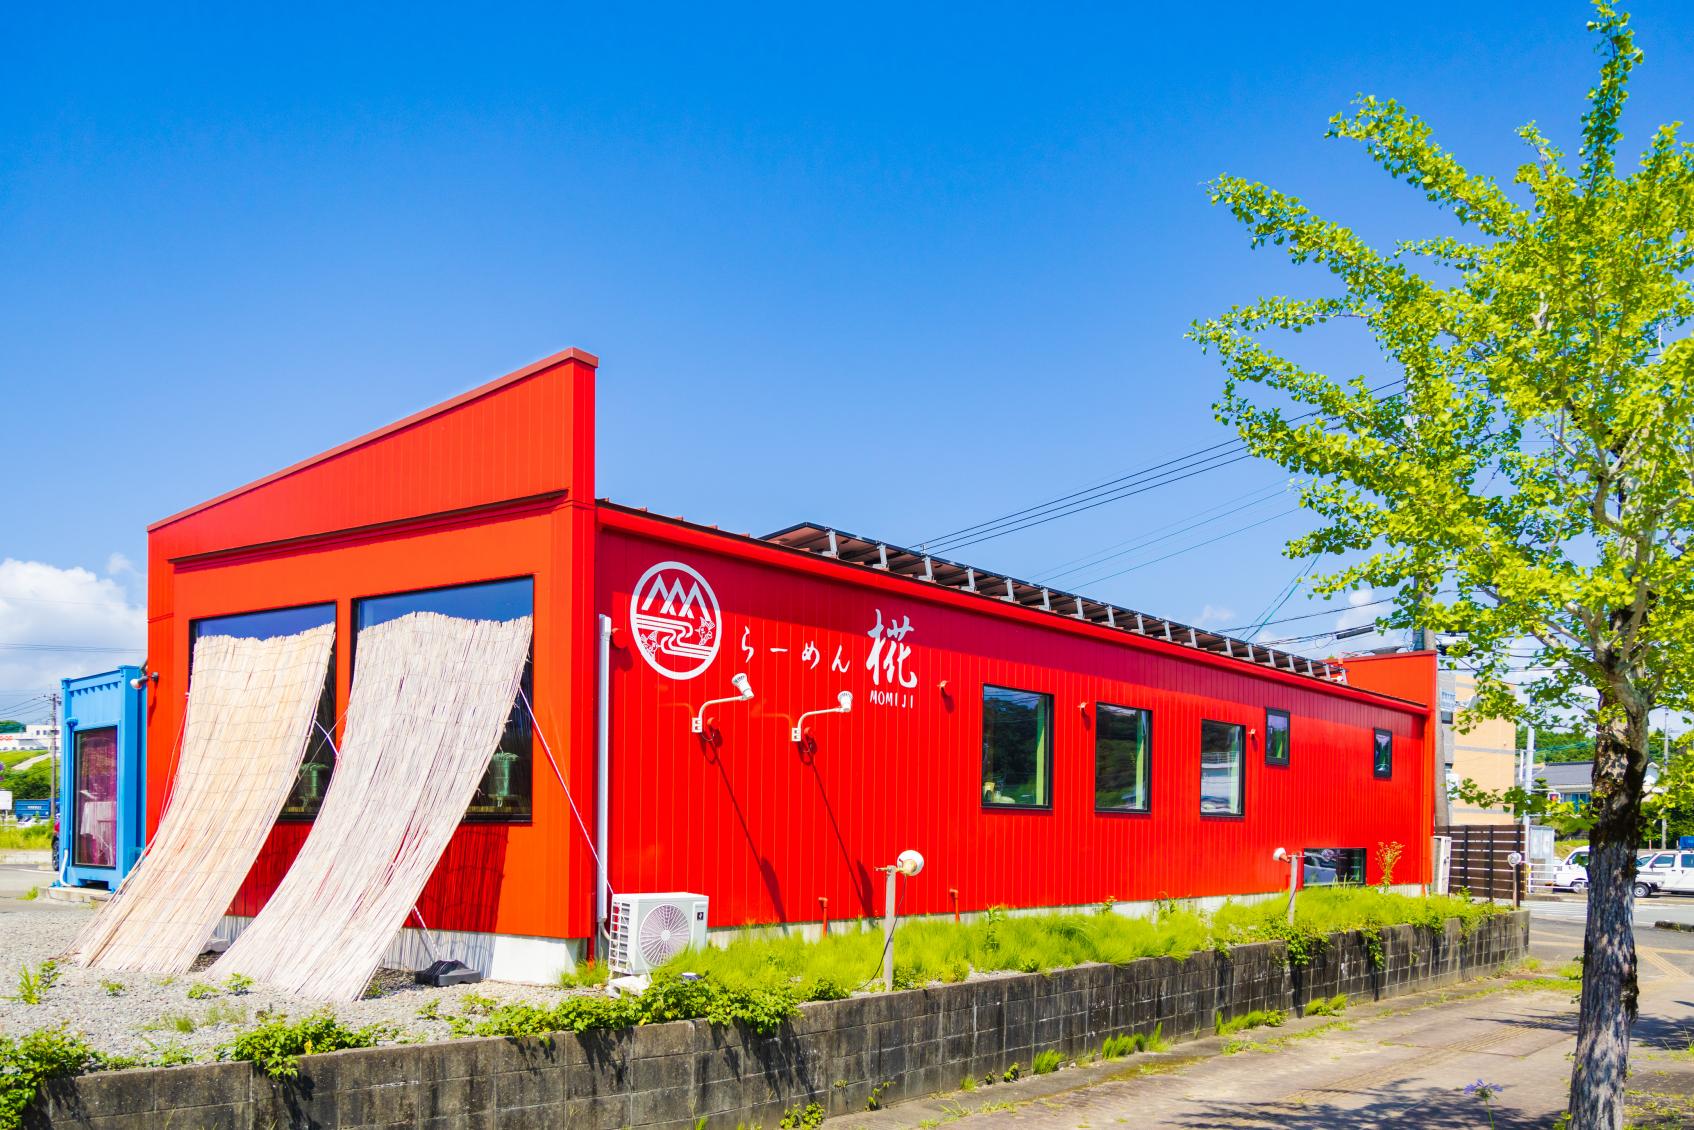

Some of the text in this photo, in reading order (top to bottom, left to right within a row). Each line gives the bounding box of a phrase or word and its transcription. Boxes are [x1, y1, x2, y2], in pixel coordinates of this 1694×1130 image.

[741, 608, 918, 689] らーめん 椛
[869, 689, 914, 709] MOMIJI
